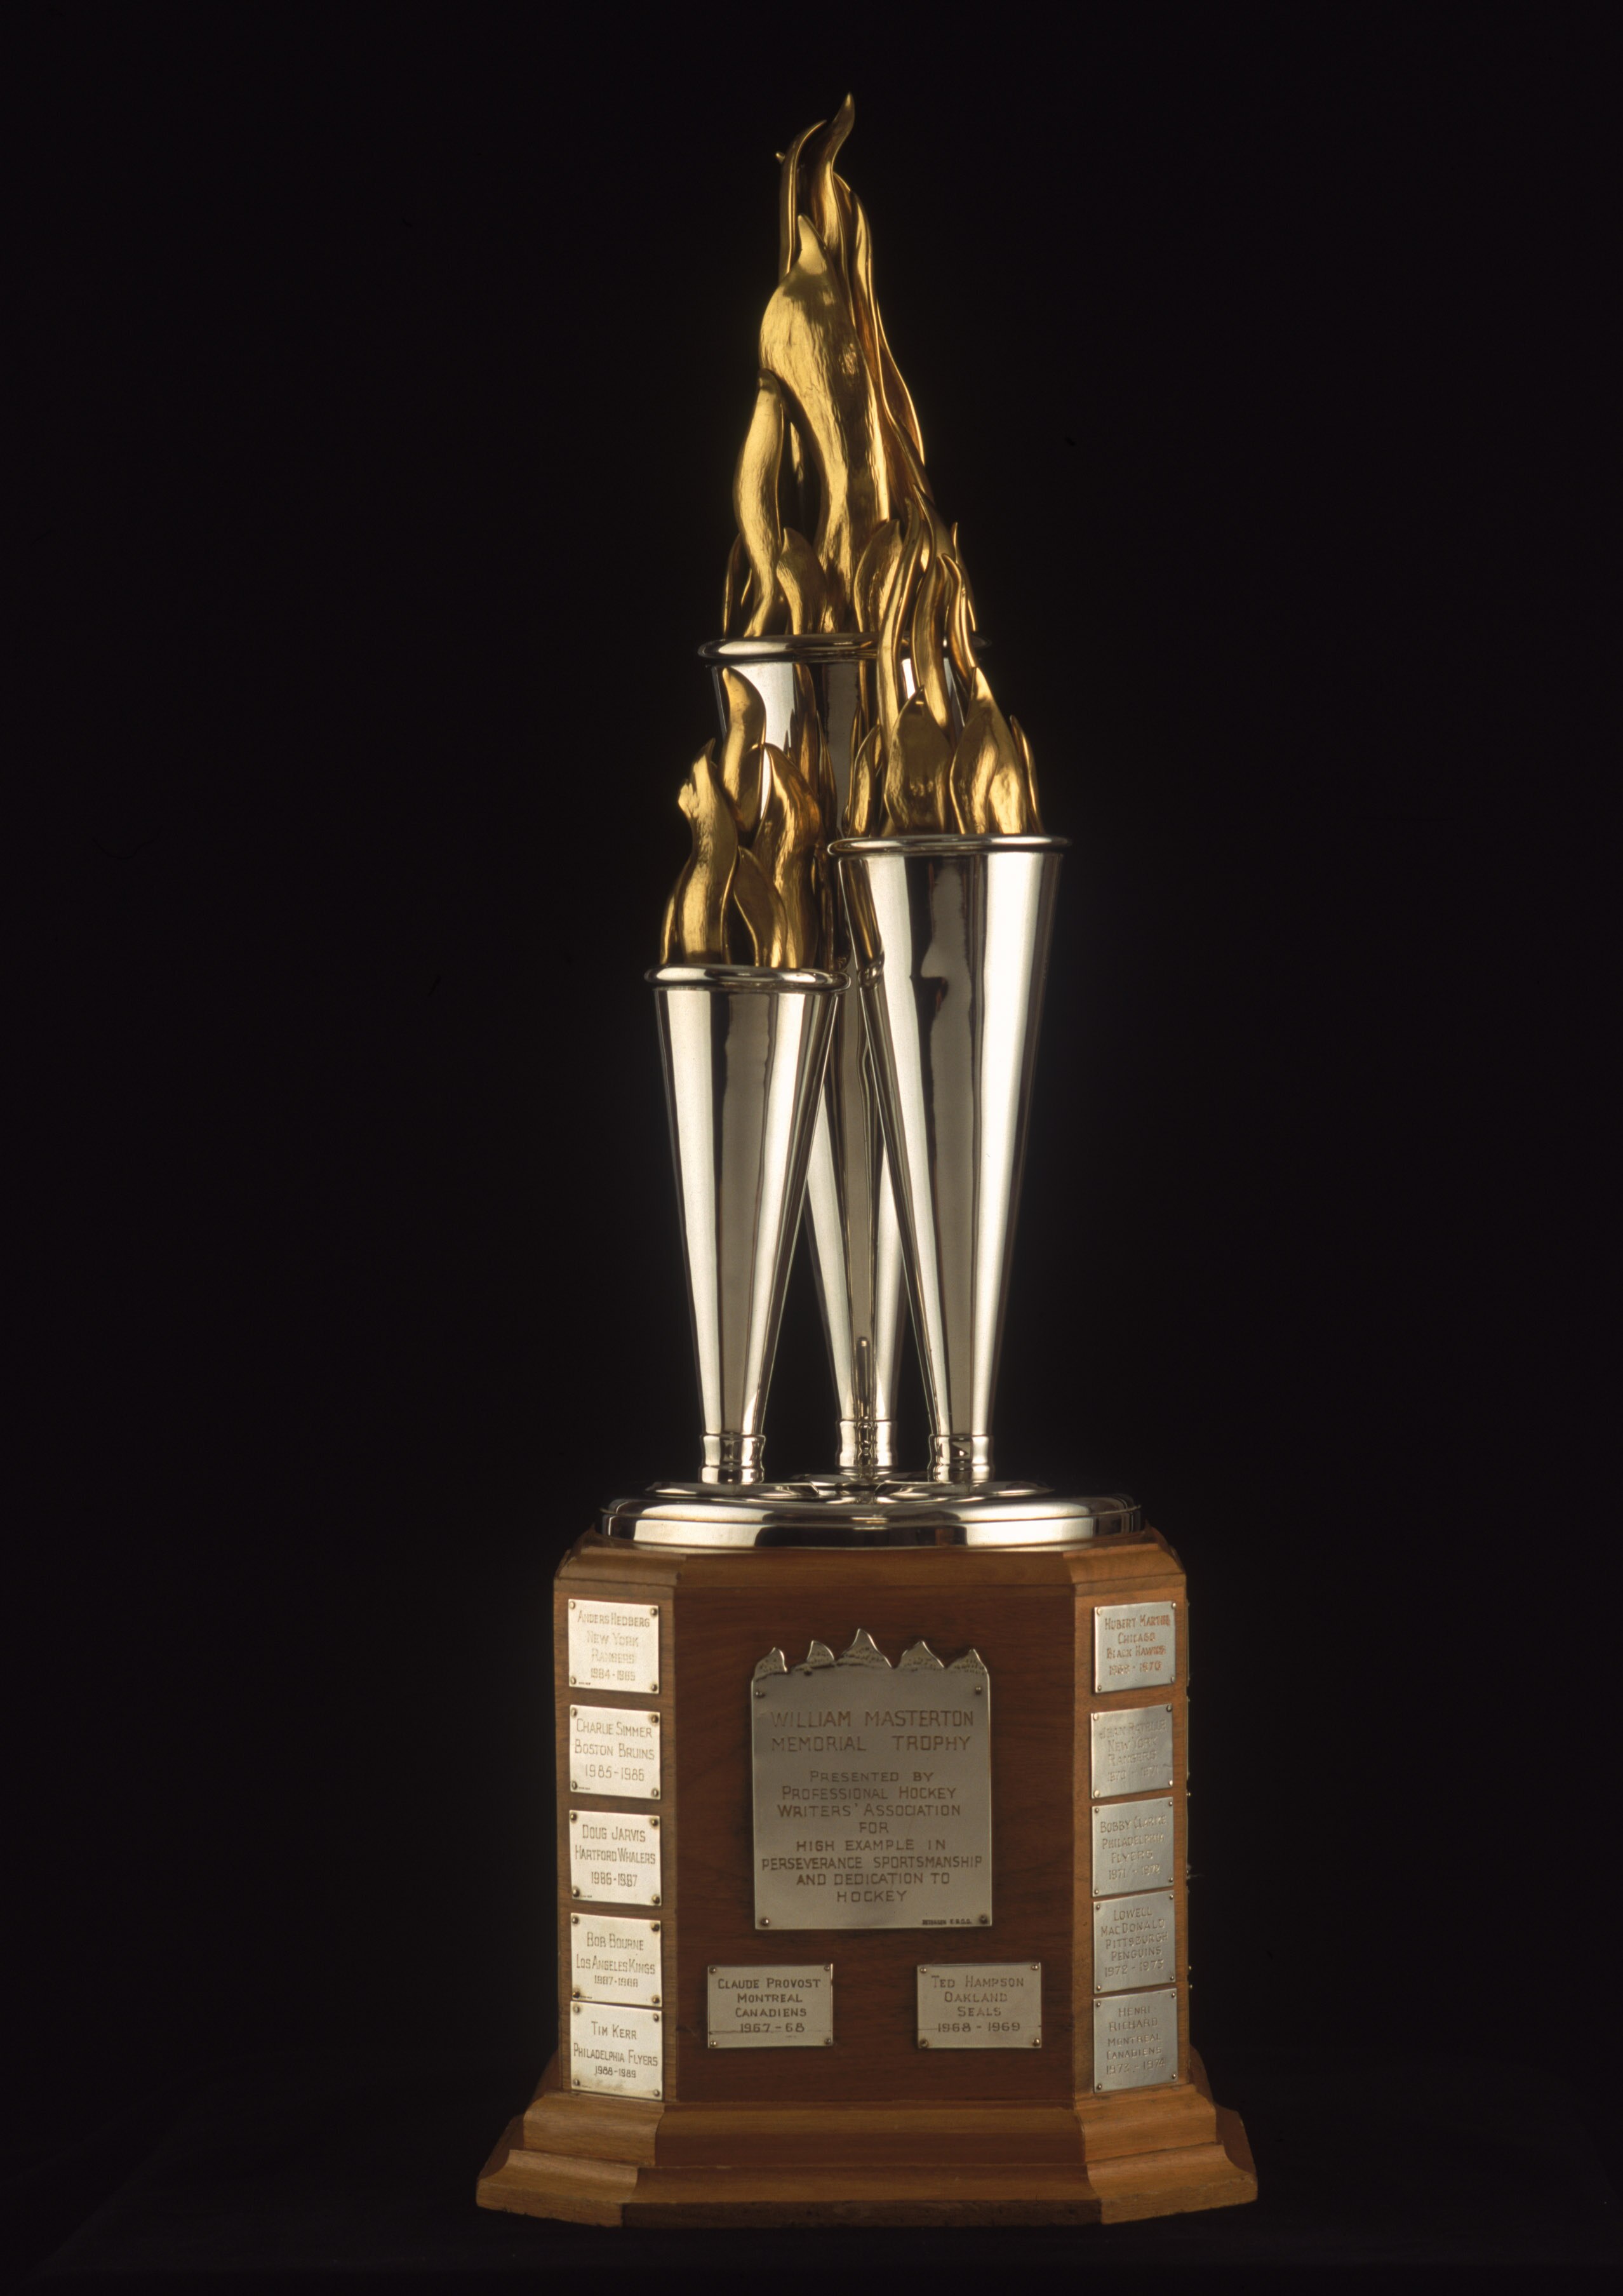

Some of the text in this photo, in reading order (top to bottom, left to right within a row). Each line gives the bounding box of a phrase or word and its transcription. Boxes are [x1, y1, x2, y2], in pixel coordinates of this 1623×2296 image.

[577, 1609, 650, 1627] ANDERS HEDBERG
[1105, 1618, 1136, 1630] HUBERT
[587, 1630, 639, 1647] NEW YORK
[1118, 1632, 1156, 1644] CHICAGO
[771, 1710, 975, 1728] WILLIAM MASTERTON
[577, 1718, 652, 1738] CHARLIE SIMMER
[575, 1739, 655, 1760] BOSTON BRUINS
[772, 1735, 971, 1752] MEMORIAL TROPHY
[810, 1771, 934, 1782] PRESENTED BY
[782, 1785, 956, 1800] PROFESSIONAL HOCKEY
[777, 1803, 961, 1818] WRITERS' ASSOCIATION
[582, 1824, 646, 1842] DOUG JARVIS
[859, 1822, 889, 1834] FOR
[1100, 1820, 1132, 1833] BOBBY
[796, 1839, 945, 1852] HIGH EXAMPLE IN
[575, 1845, 655, 1864] HARTFORD WHALERS
[1111, 1850, 1153, 1863] FLYERS
[762, 1855, 982, 1870] PERSEVERANCE SPORTSMANSHIP
[796, 1872, 950, 1886] AND DEDICATION TO
[837, 1890, 907, 1903] HOCKEY
[1114, 1907, 1152, 1921] LOWELL
[1101, 1919, 1165, 1937] MACDONALD
[587, 1931, 644, 1950] BOB BOURNE
[1106, 1932, 1168, 1949] PITTSBURGH
[1112, 1947, 1161, 1961] PENGUINS
[577, 1954, 655, 1975] LOS ANGELES KINGS
[718, 1978, 821, 1989] CLAUDE PROVOST
[932, 1975, 1024, 1988] TED HAMPSON
[738, 1994, 803, 2003] MONTREAL
[944, 1992, 1008, 2003] OAKLAND
[735, 2008, 806, 2017] CANADIENS
[958, 2006, 1001, 2017] SEALS
[1119, 2006, 1150, 2017] HENRI
[591, 2021, 637, 2039] TIM KERR
[1109, 2017, 1158, 2032] RICHARD
[1108, 2033, 1161, 2046] MONTREAL
[574, 2043, 658, 2066] PHILADELPHIA FLYERS
[1107, 2047, 1162, 2060] CANADIENS
